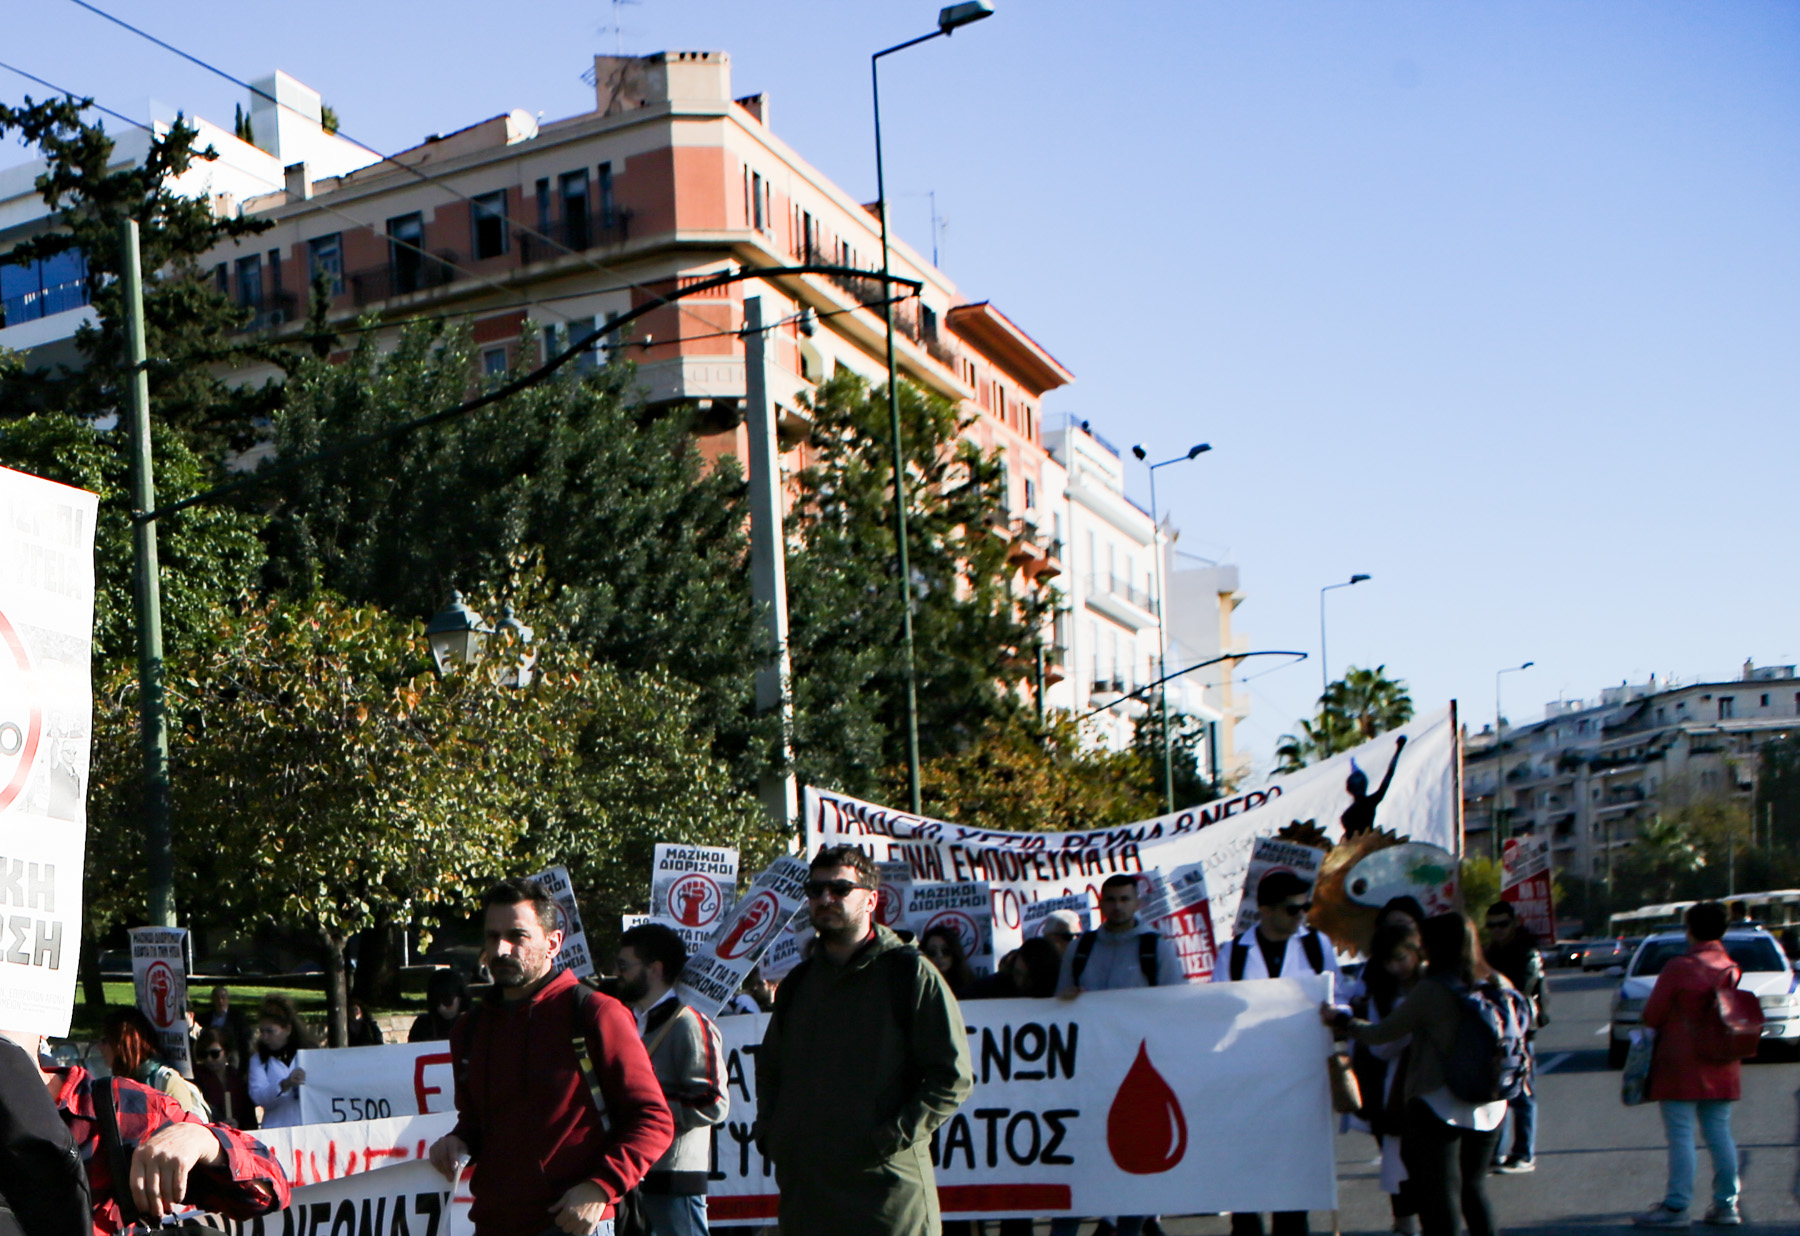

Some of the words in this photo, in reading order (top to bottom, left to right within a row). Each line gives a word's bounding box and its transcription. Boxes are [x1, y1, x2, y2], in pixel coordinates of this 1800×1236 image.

[1197, 785, 1282, 831] ΝΕΡΟ
[666, 848, 725, 863] ΜΑΖΙΚΟΙ
[888, 843, 946, 881] ΕΙΝΑΙ
[950, 843, 1143, 882] ΕΜΠΟΡΕΥΜΑΤΑ
[659, 858, 733, 875] ΔΙΟΡΙΣΜΟΙ
[913, 885, 976, 899] ΜΑΖΙΚΟΙ
[908, 896, 988, 912] ΔΙΟΡΙΣΜΟΙ
[967, 1022, 1078, 1084] ΝΩΝ
[331, 1097, 391, 1123] 5500
